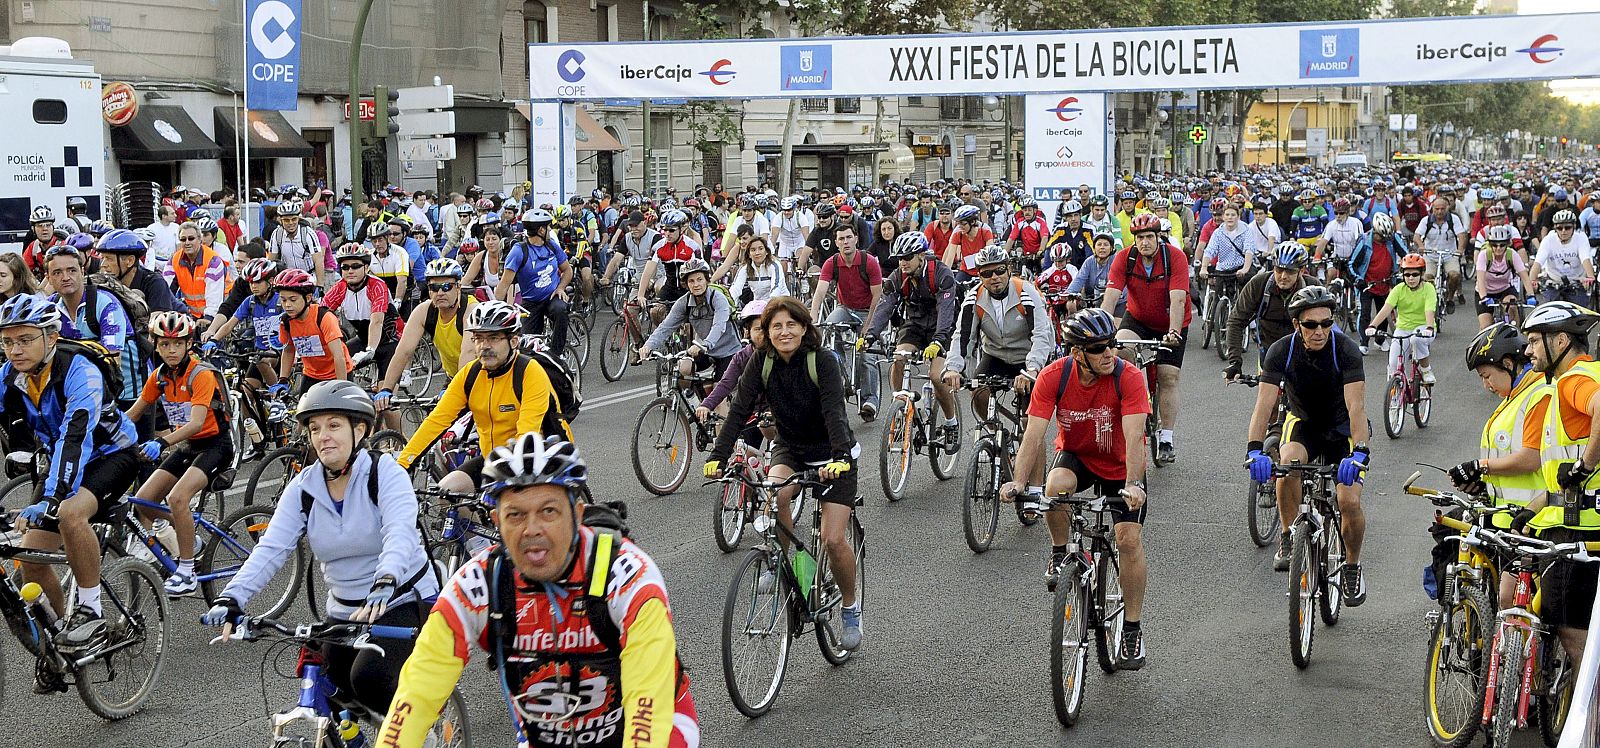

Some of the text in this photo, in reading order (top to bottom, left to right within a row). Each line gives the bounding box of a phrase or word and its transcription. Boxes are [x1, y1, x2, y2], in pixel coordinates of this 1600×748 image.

[1416, 42, 1507, 62] iberCaja
[889, 38, 1240, 81] XXXI FIESTA DE LA BICICLETA
[252, 63, 294, 82] COPE
[620, 64, 692, 83] iberCaja
[80, 80, 92, 89] 112
[557, 85, 586, 96] COPE
[102, 91, 128, 108] Mahou
[1046, 127, 1083, 137] iberCaja
[7, 153, 45, 165] POLICÍA
[13, 172, 46, 182] madrid
[1035, 188, 1050, 200] LA
[538, 724, 617, 745] shop
